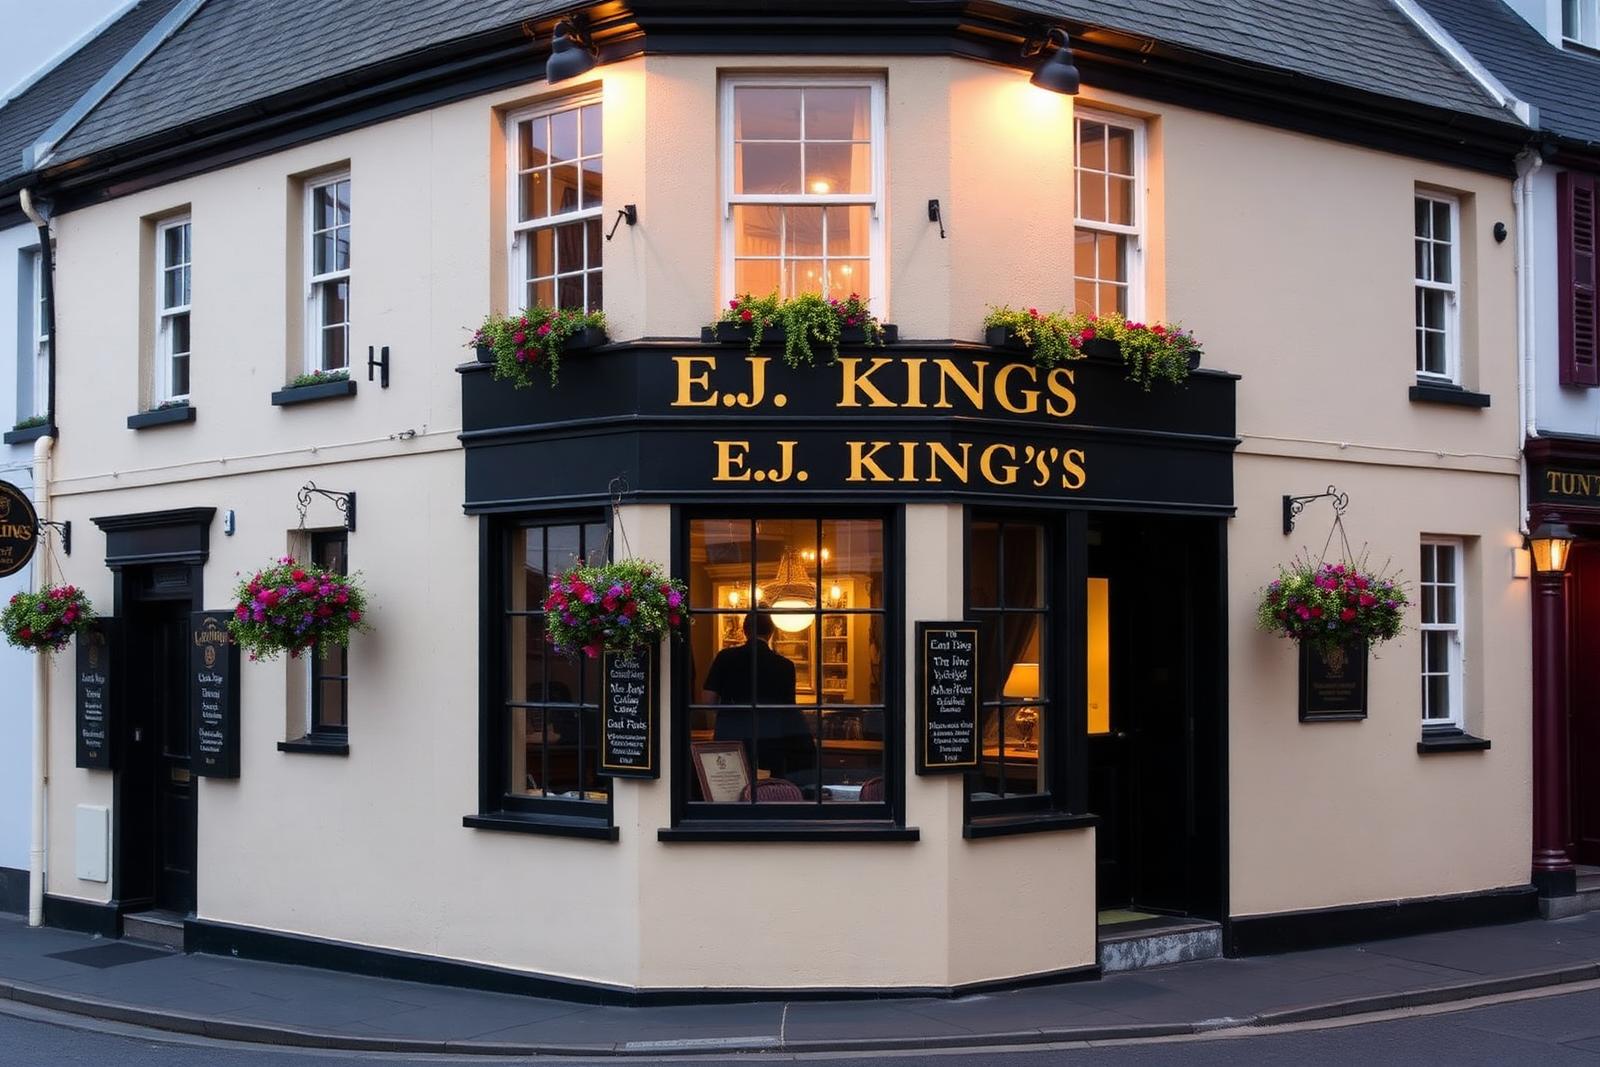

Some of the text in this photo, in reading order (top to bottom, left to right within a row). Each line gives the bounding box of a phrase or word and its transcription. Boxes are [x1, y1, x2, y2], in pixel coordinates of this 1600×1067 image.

[670, 356, 1077, 417] E.J. KINGS
[712, 440, 809, 483] E.J.
